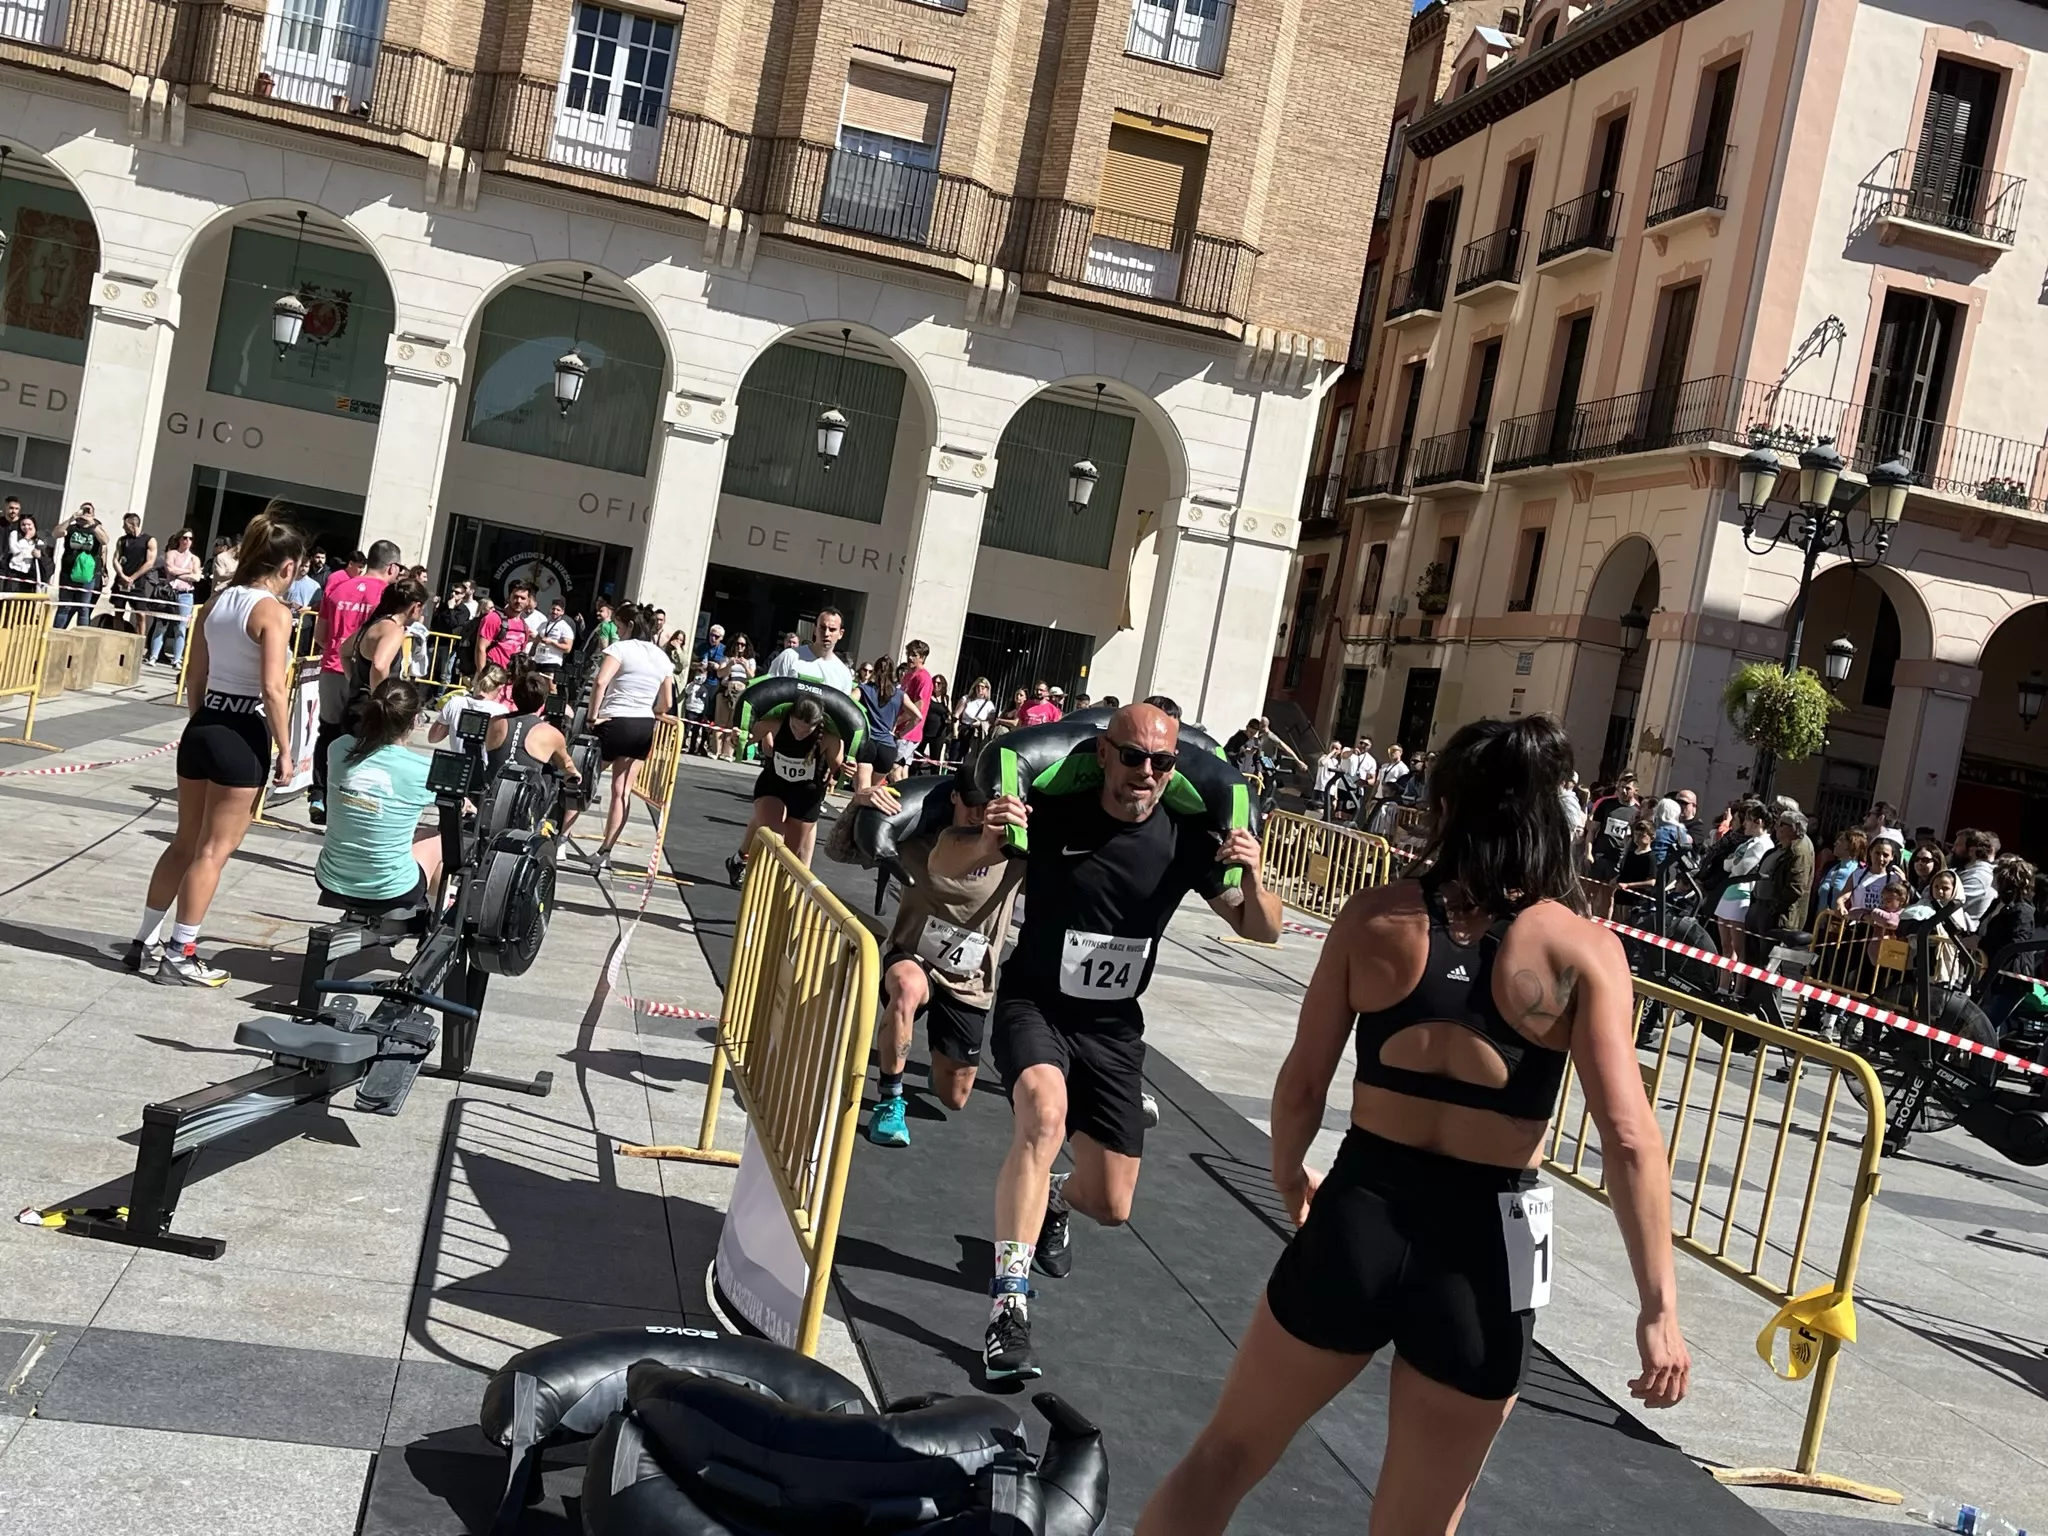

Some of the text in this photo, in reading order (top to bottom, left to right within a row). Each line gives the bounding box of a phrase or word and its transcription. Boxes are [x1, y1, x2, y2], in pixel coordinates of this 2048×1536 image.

[748, 525, 790, 552] DE
[508, 721, 523, 760] SANDRA
[781, 765, 806, 778] 109
[937, 940, 964, 966] 74
[1082, 939, 1108, 950] FITNESS
[1080, 958, 1131, 989] 124
[1446, 973, 1470, 982] adidas
[1936, 1068, 1970, 1090] ECHO BIKE
[1895, 1076, 1924, 1128] ROGUE
[645, 1326, 719, 1339] 20KG
